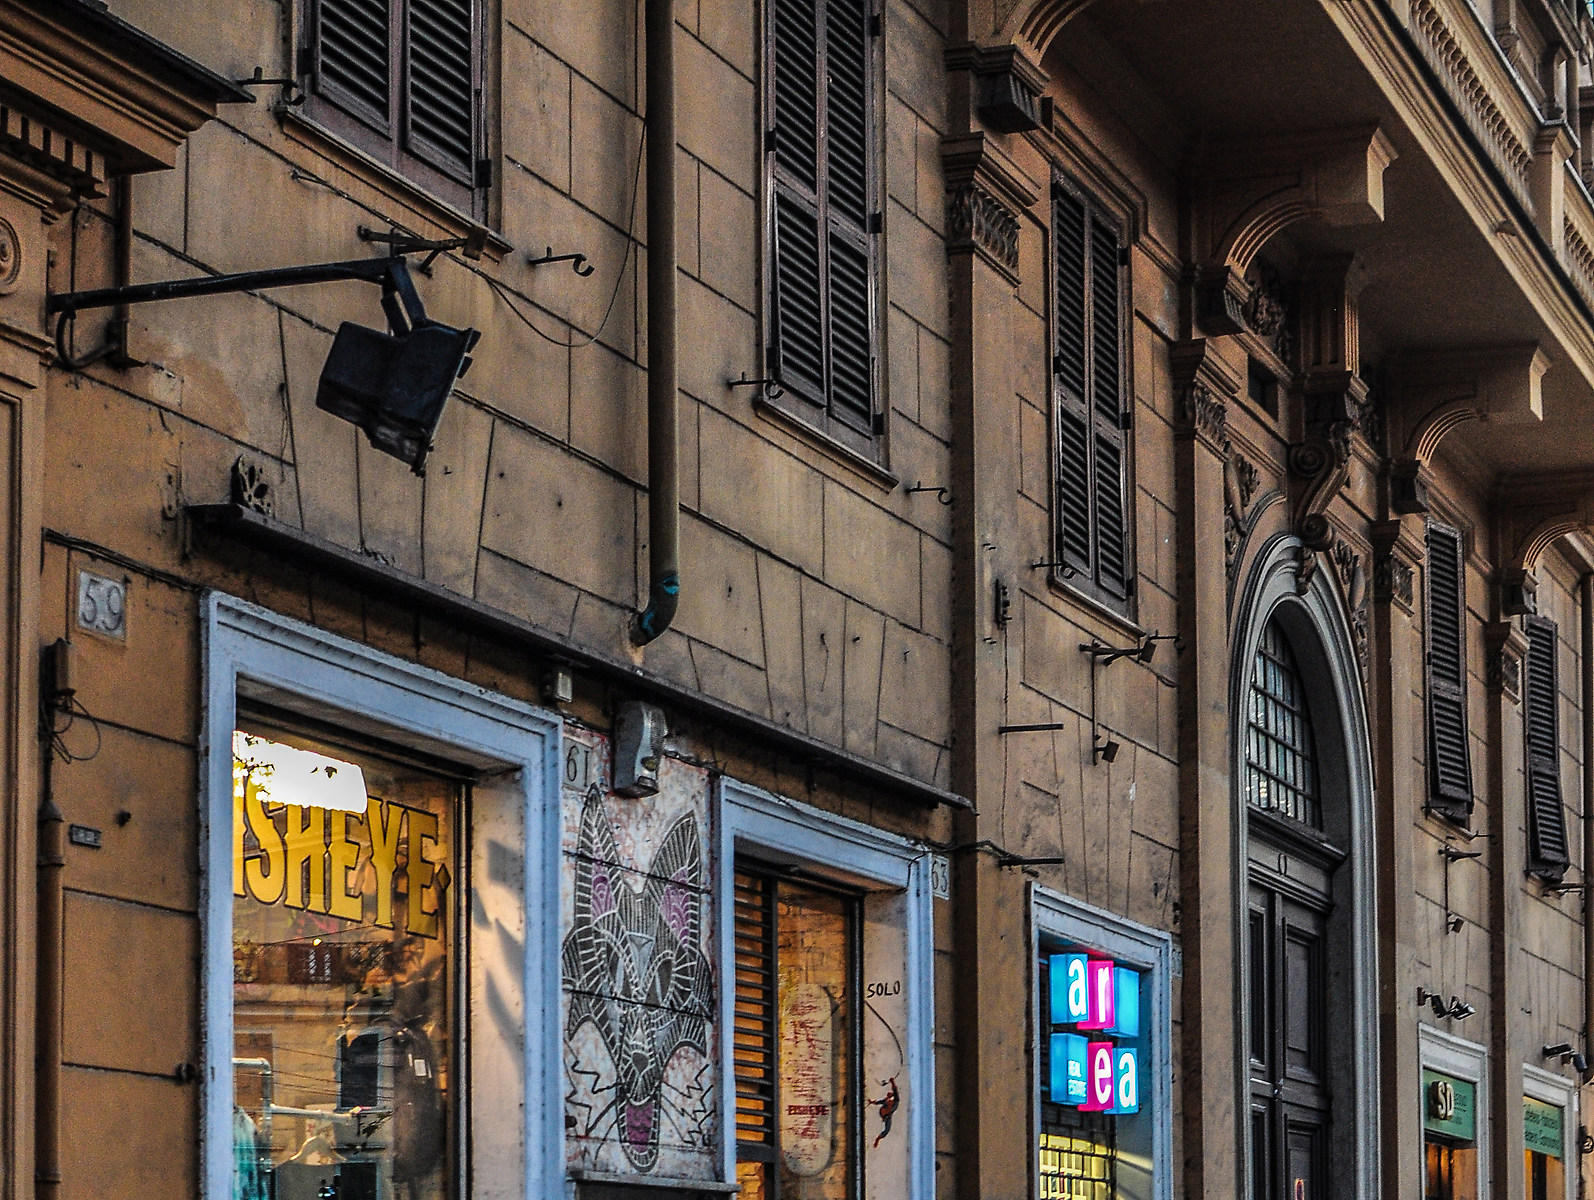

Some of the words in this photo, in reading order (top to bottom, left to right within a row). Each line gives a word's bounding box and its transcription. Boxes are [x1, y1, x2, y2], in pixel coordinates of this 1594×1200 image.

[82, 578, 122, 631] 59
[566, 745, 589, 788] 61
[867, 981, 900, 998] SOLO
